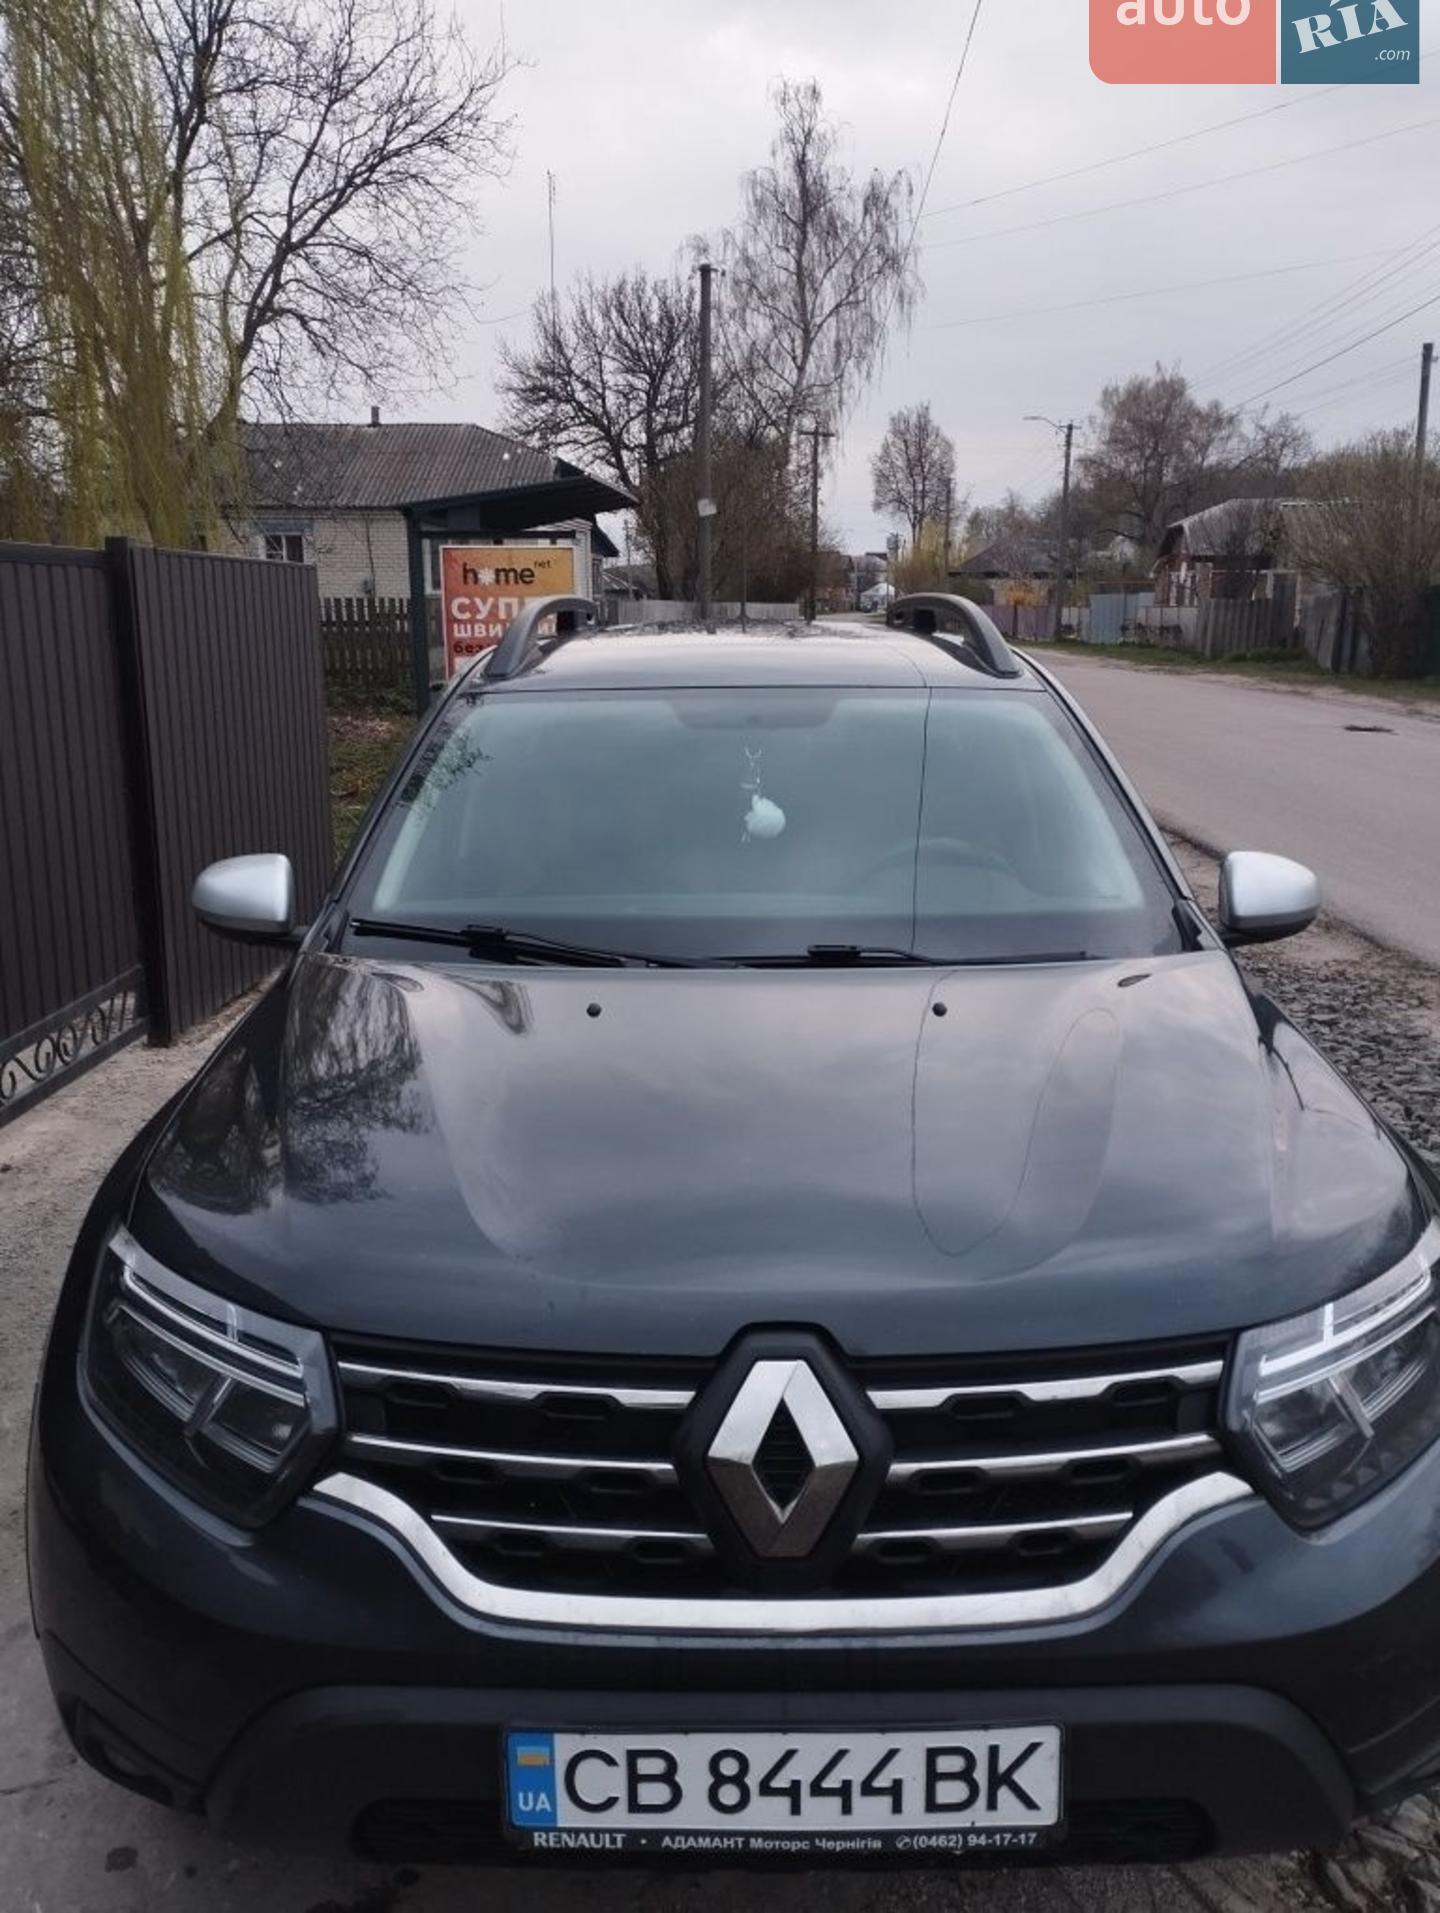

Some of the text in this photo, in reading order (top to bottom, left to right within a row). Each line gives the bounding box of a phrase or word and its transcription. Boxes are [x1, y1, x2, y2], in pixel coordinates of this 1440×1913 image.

[564, 1741, 1044, 1816] CB 8444 BK
[518, 1792, 551, 1812] UA
[533, 1832, 626, 1849] RENAULT
[661, 1832, 1038, 1852] АДАМАНТ Моторс Чернігів (0462) 94-17-17
